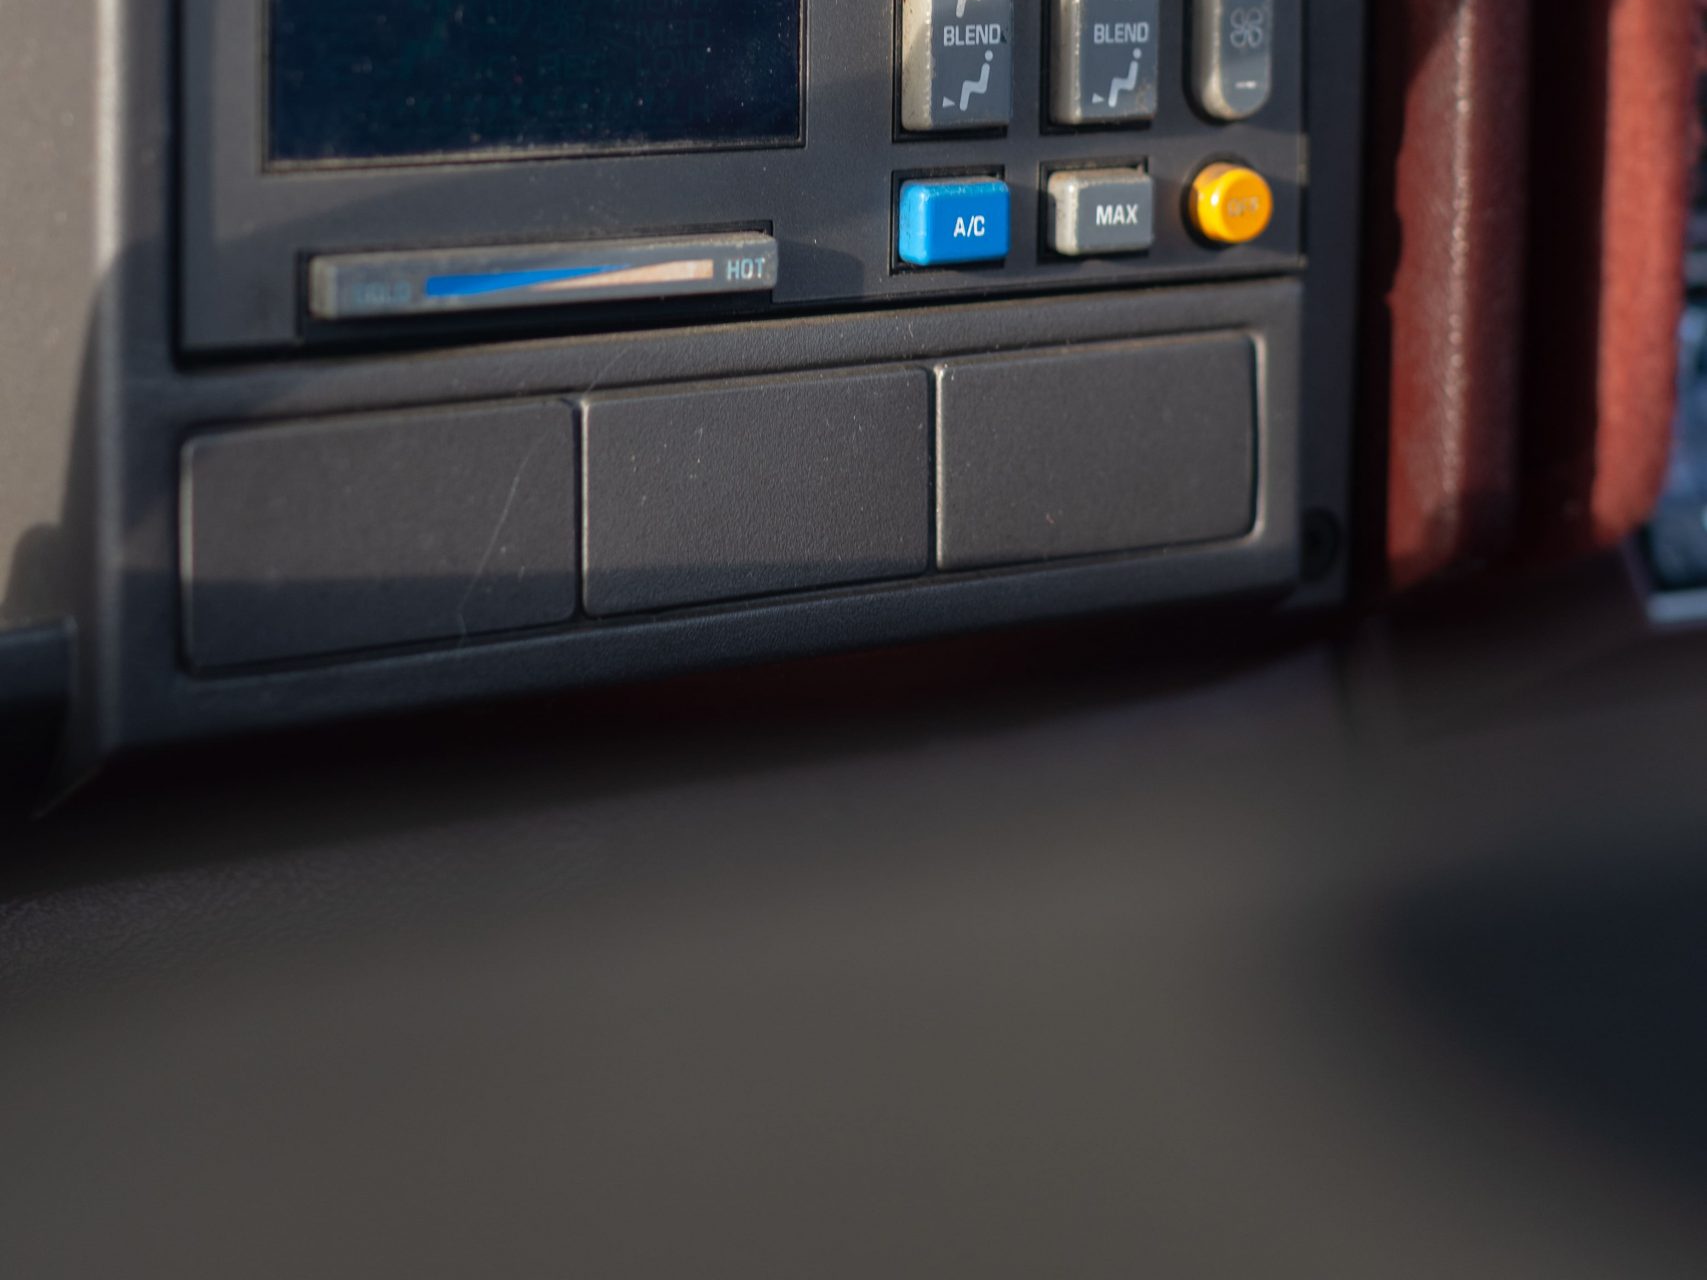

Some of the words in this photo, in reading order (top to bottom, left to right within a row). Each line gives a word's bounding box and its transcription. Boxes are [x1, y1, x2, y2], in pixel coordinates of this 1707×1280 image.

[943, 23, 1001, 47] BLEND
[1093, 21, 1150, 44] BLEND
[953, 215, 986, 238] A/C
[1095, 204, 1139, 226] MAX
[727, 258, 767, 281] HOT
